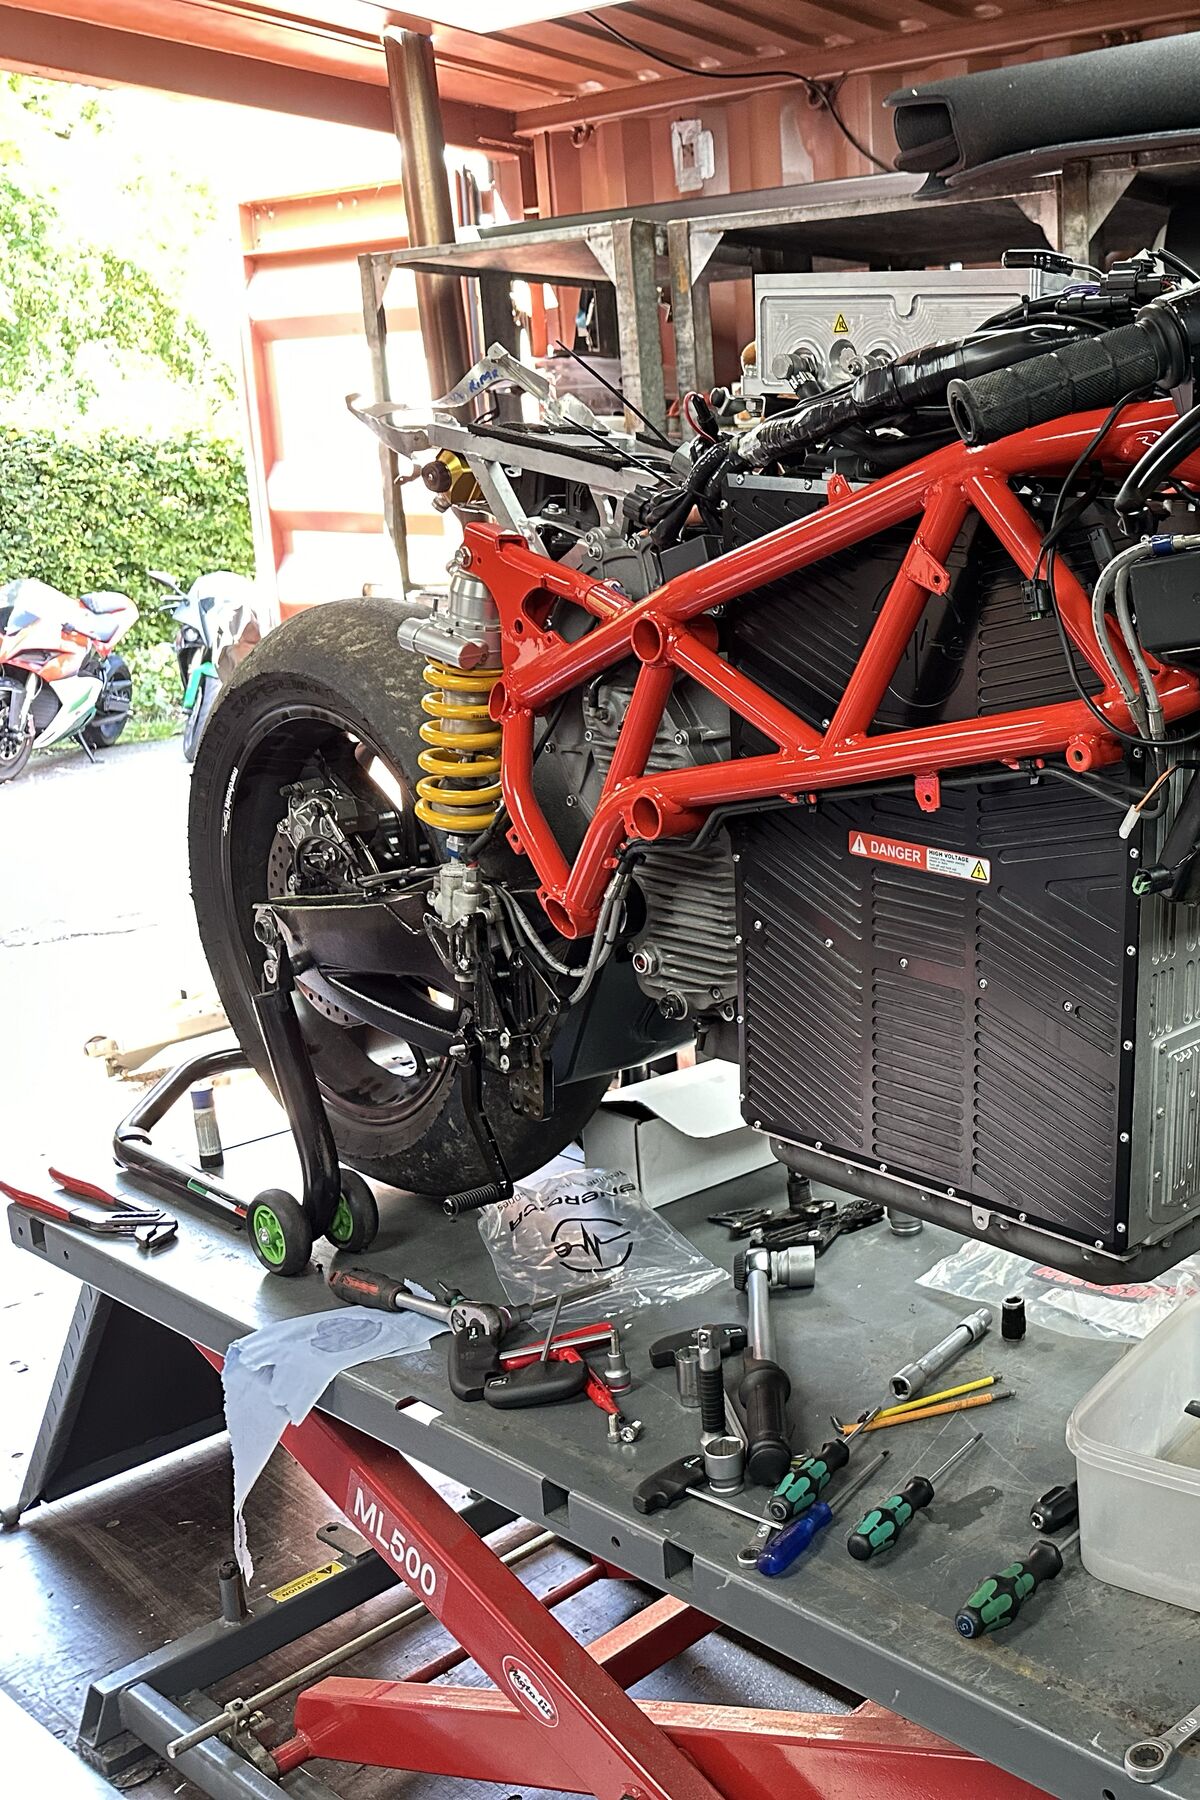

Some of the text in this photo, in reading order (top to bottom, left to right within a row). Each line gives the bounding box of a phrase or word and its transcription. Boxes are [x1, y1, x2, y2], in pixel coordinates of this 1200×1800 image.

[870, 840, 969, 864] DANGER HIGH VOLTAGE
[353, 1486, 437, 1597] ML500
[281, 1577, 319, 1598] CAUTION
